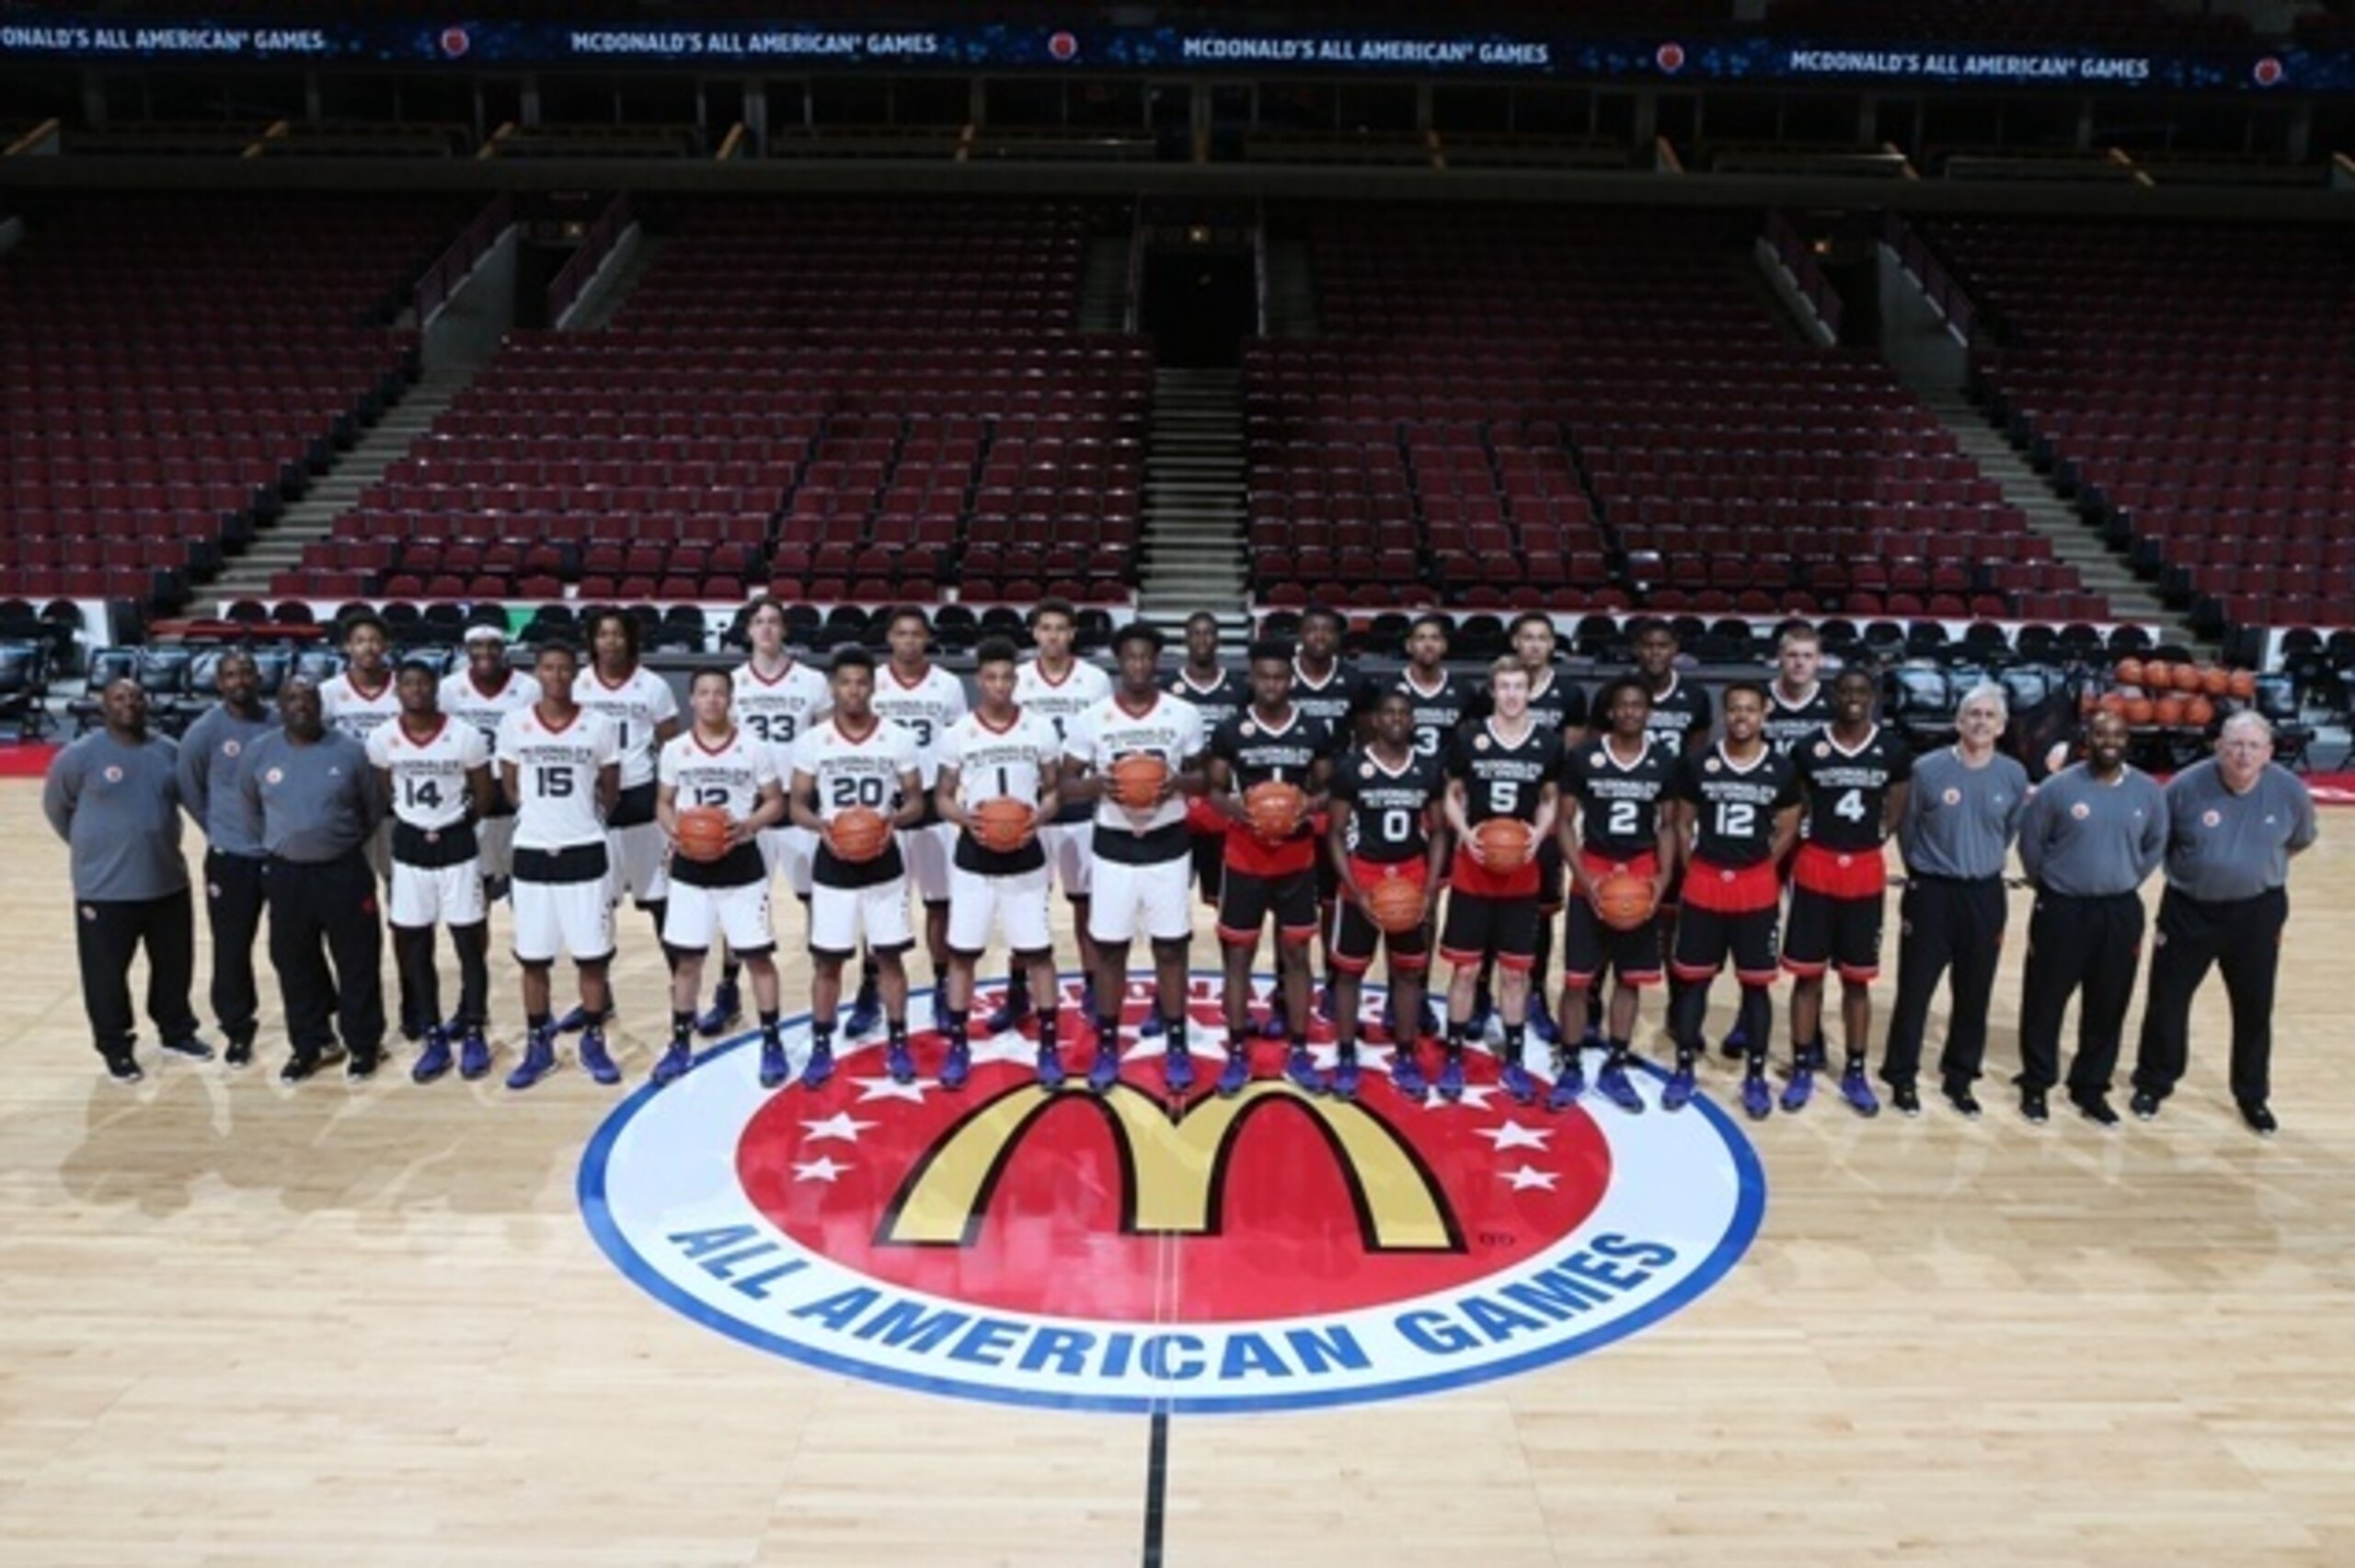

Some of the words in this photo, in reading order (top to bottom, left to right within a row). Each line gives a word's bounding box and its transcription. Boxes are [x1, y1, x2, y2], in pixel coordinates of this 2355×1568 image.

[95, 29, 131, 50] ALL
[254, 30, 324, 51] GAMES
[570, 32, 702, 52] MCDONALD'S
[707, 32, 742, 52] ALL
[867, 33, 937, 53] GAMES
[1183, 38, 1315, 60] MCDONALD'S
[1318, 40, 1355, 61] ALL
[1479, 43, 1548, 64] GAMES
[1790, 51, 1920, 74] MCDONALD'S
[1924, 54, 1959, 75] ALL
[2080, 58, 2150, 79] GAMES
[745, 714, 797, 743] 33
[405, 777, 443, 809] 14
[536, 766, 574, 798] 15
[832, 776, 883, 808] 20
[997, 766, 1008, 796] 1
[1490, 781, 1519, 814] 5
[1834, 788, 1866, 823] 4
[1383, 809, 1411, 842] 0
[1608, 800, 1639, 835] 2
[1716, 802, 1755, 837] 12
[667, 1224, 810, 1301] ALL
[788, 1285, 1373, 1380] AMERICAN
[1393, 1232, 1678, 1356] GAMES
